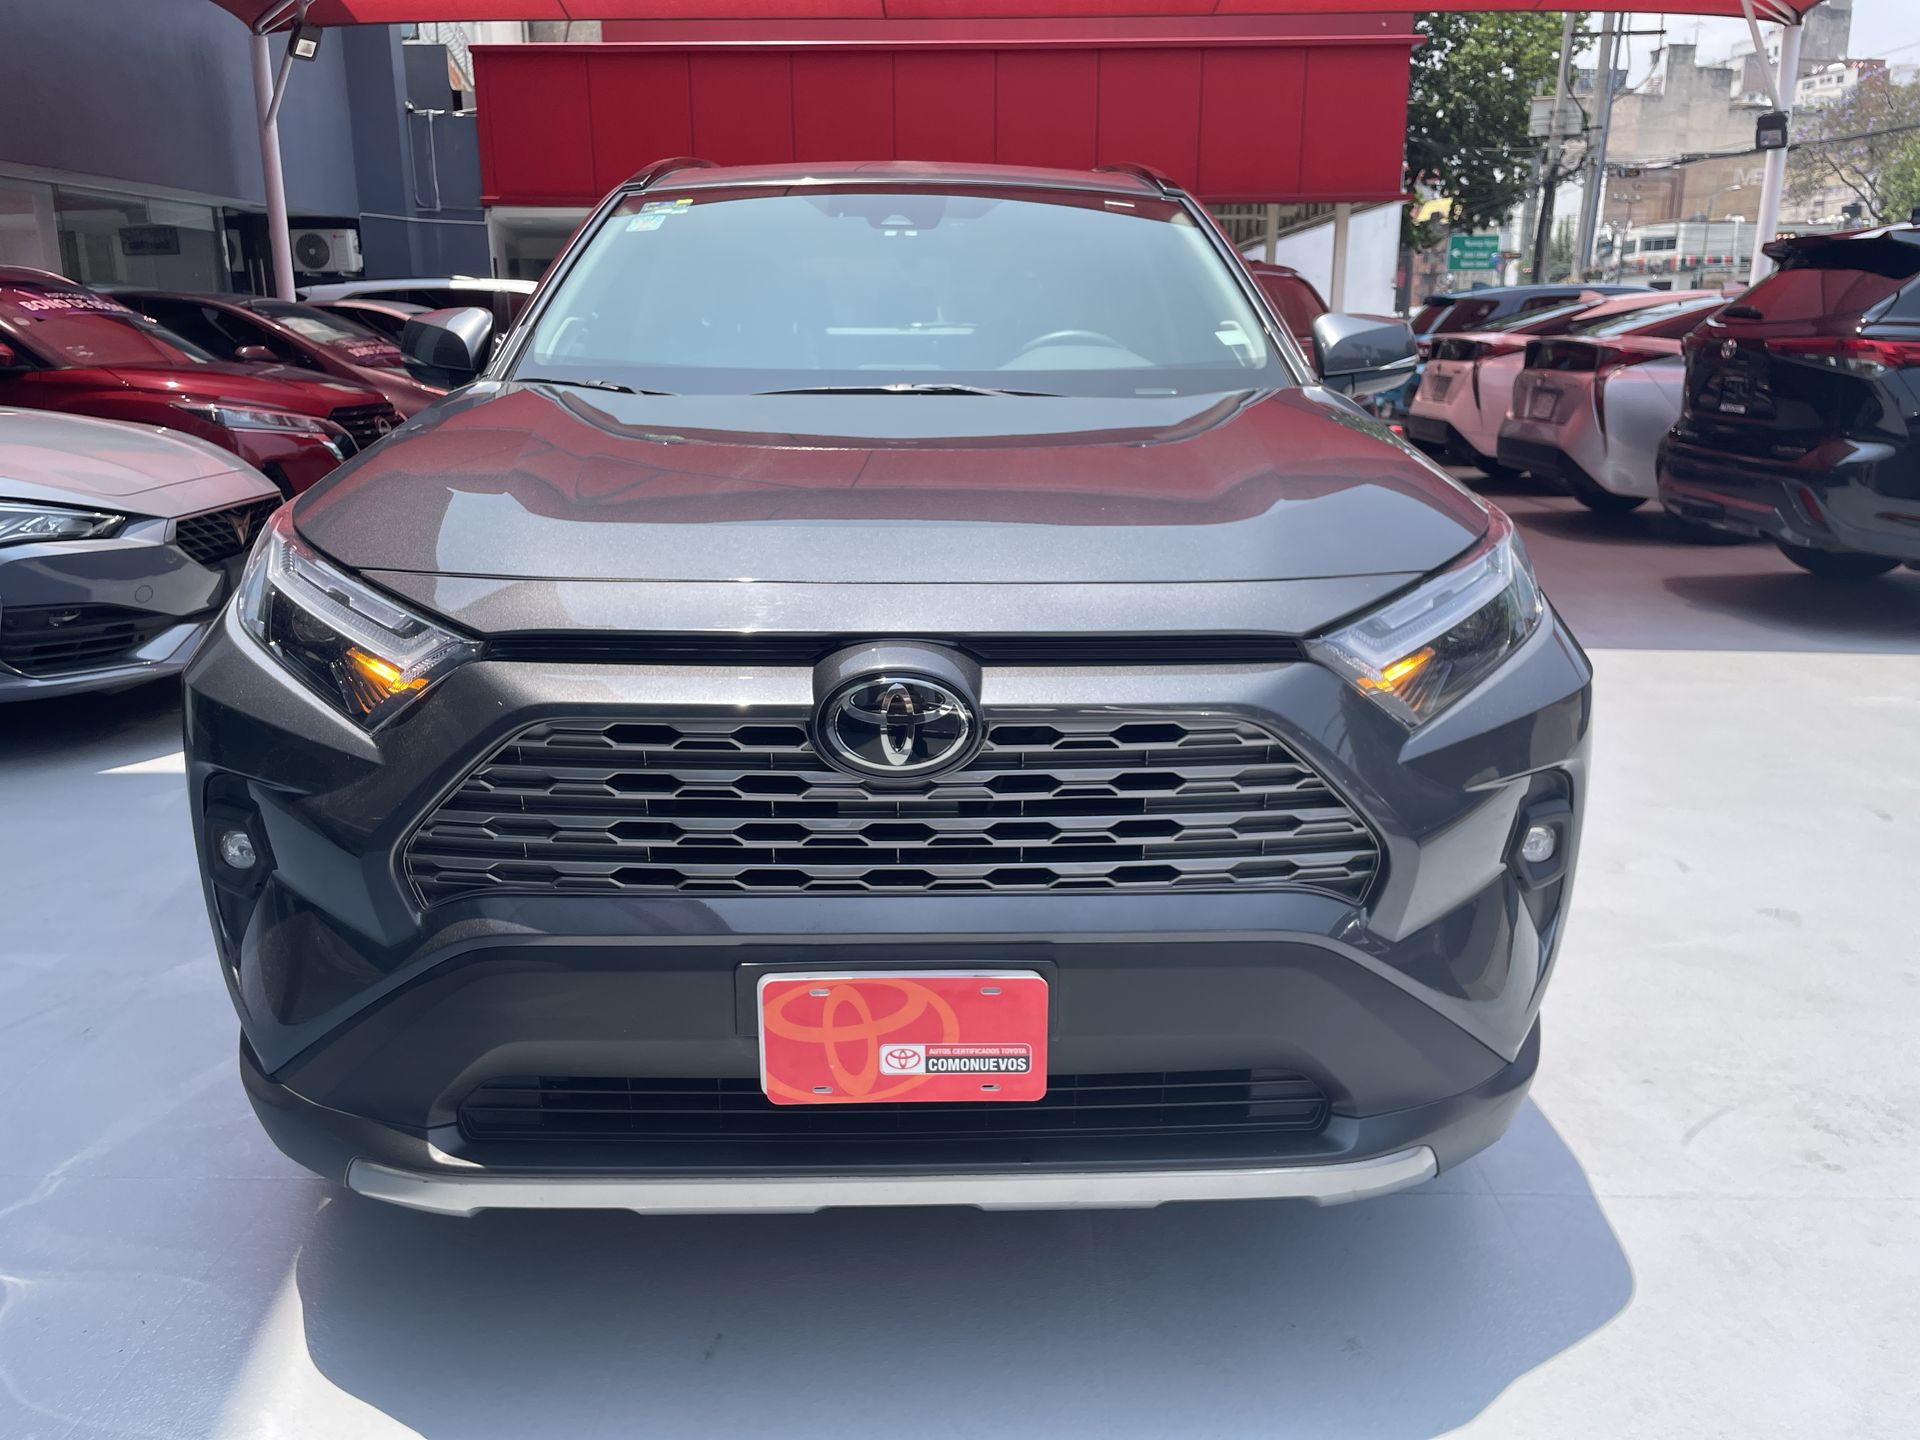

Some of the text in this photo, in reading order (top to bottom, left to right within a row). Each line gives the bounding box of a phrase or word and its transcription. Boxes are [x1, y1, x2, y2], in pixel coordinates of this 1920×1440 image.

[19, 299, 71, 311] BONO
[929, 1047, 1027, 1055] AUTOS CERTIFICADOS TOYOTA
[928, 1058, 1027, 1072] COMONUEVOS
